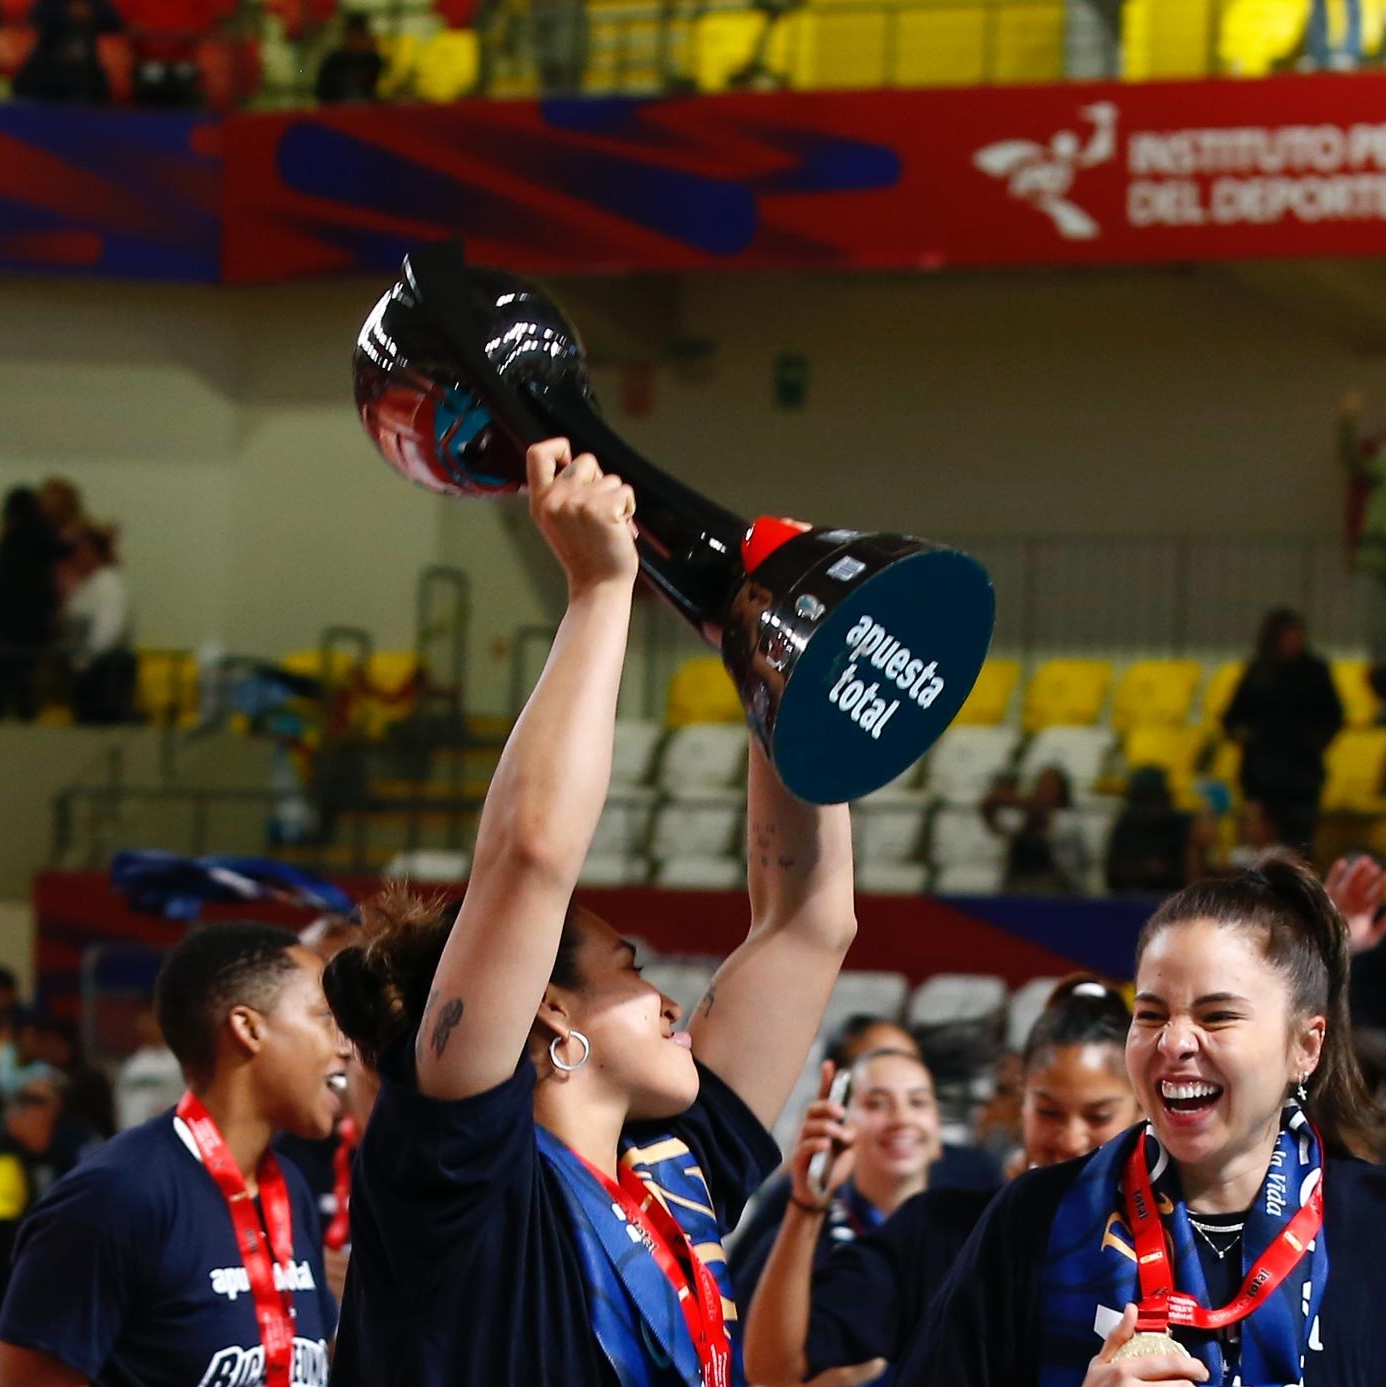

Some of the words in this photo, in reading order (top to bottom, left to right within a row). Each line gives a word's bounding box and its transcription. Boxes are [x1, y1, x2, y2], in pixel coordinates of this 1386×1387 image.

[1127, 125, 1345, 174] INSTITUTO
[1126, 178, 1205, 227] DEL
[845, 614, 946, 711] apuesta
[828, 662, 901, 741] total
[1266, 1173, 1287, 1217] Vida
